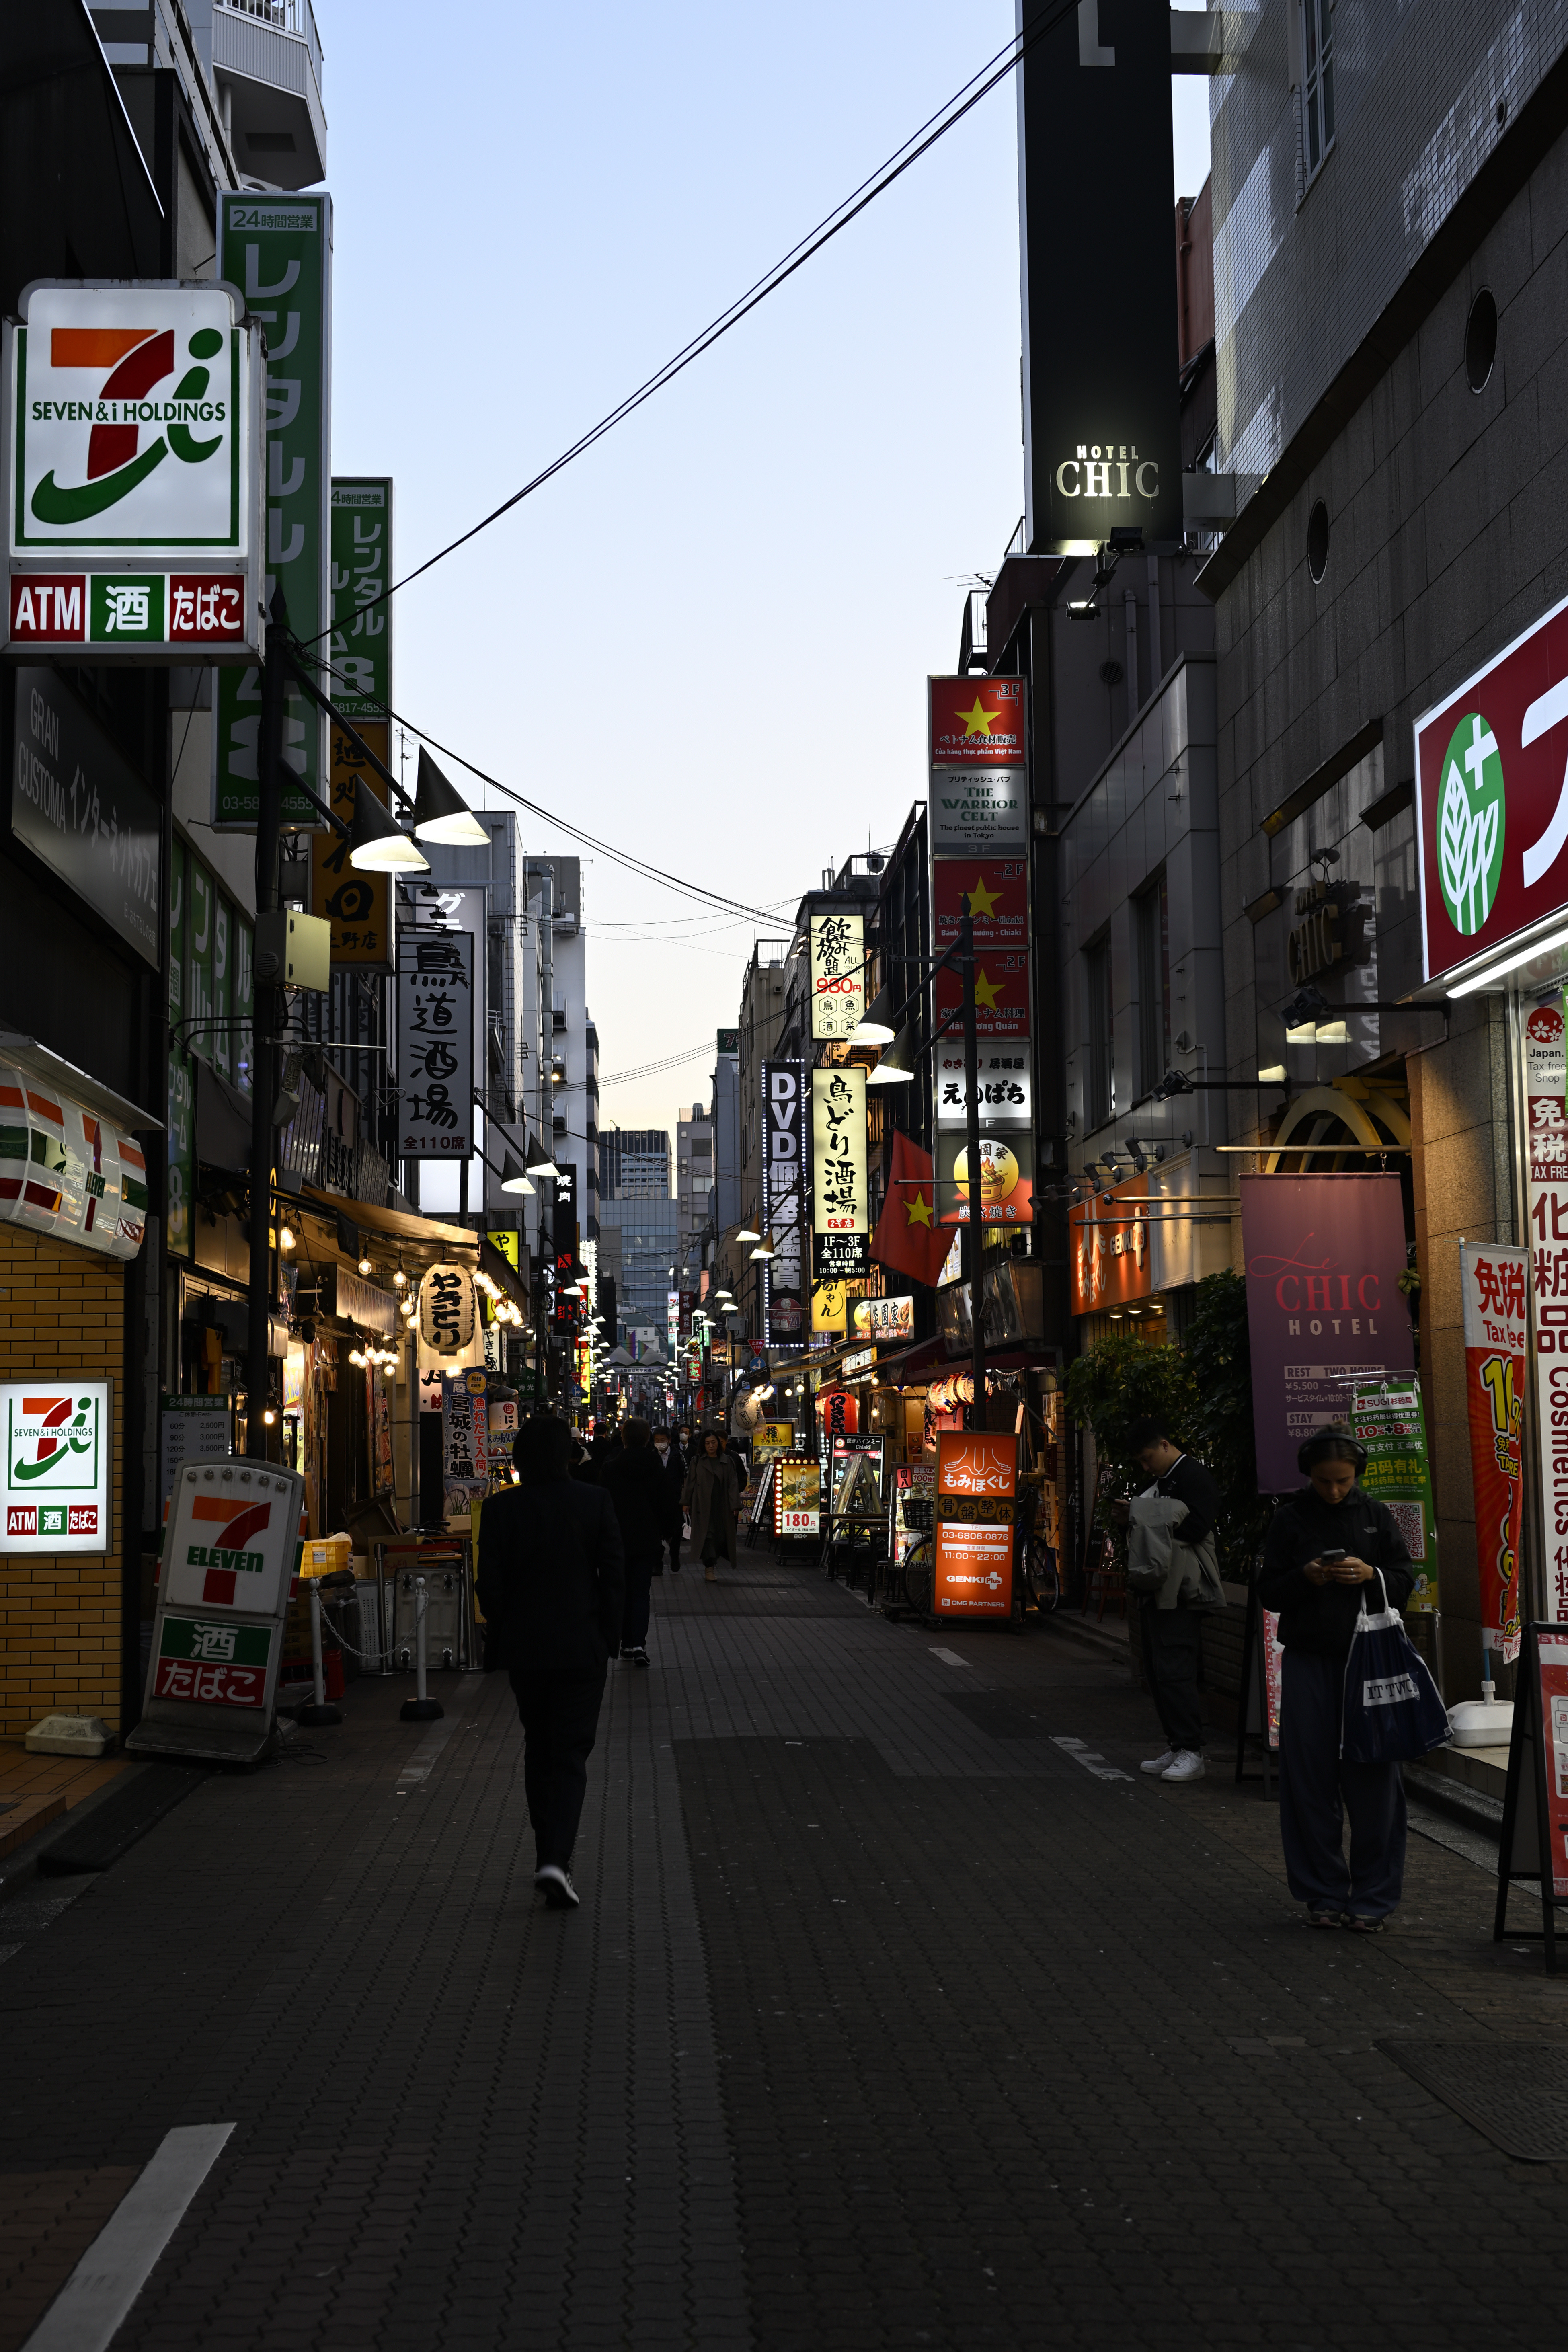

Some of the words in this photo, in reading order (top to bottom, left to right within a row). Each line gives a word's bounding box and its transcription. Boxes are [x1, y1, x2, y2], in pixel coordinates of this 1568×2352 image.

[232, 210, 314, 229] 24時間営業
[123, 402, 226, 422] HOLDINGS
[1077, 445, 1138, 459] HOTEL
[1056, 462, 1159, 497] CHIC
[351, 516, 384, 636] レンタル
[15, 586, 80, 630] ATM
[105, 585, 150, 633] 酒
[173, 585, 241, 631] たばこ
[31, 687, 59, 761] GRAN
[940, 734, 1017, 745] ベトナム食材販売
[18, 741, 67, 835] CUSTOMA
[964, 787, 993, 797] THE
[940, 798, 1018, 809] WARRIOR
[961, 811, 998, 821] CELT
[70, 763, 157, 913] インターネットカフェ
[817, 978, 861, 993] 980円
[823, 1001, 833, 1010] 鳥
[845, 1000, 855, 1010] 魚
[823, 1022, 833, 1031] 酒
[846, 1021, 855, 1031] 菜
[995, 1022, 1018, 1030] Quán
[1530, 1048, 1564, 1059] Japan.
[989, 1058, 1024, 1069] 居酒屋
[1528, 1062, 1566, 1071] Tax-free
[1535, 1073, 1560, 1084] Shop
[1532, 1098, 1567, 1163] 免税
[404, 1136, 465, 1150] 全110席
[823, 1075, 857, 1215] 鳥どり酒場
[556, 1175, 573, 1202] 焼肉
[768, 1072, 801, 1289] DVD個室鑑賞
[830, 1219, 852, 1227] 2号店
[1110, 1229, 1133, 1256] GENKI
[1133, 1229, 1143, 1245] Plus
[821, 1247, 862, 1259] 全110席
[1078, 1260, 1106, 1303] もみほぐし
[1276, 1274, 1381, 1311] CHIC
[429, 1273, 462, 1346] やきとり
[1289, 1319, 1377, 1335] HOTEL
[1483, 1320, 1506, 1343] Tax
[688, 1362, 700, 1377] 和光
[1287, 1368, 1311, 1377] REST
[1324, 1367, 1346, 1377] TWO
[1285, 1382, 1318, 1391] ¥5,500
[169, 1398, 224, 1407] 24時間営業
[1367, 1398, 1390, 1407] SUGI
[1391, 1397, 1412, 1405] 杉药局
[1289, 1414, 1313, 1423] STAY
[51, 1428, 93, 1437] HOLDINGS
[449, 1394, 475, 1479] 宮城の牡蠣
[944, 1472, 1010, 1492] もみほぐし
[942, 1499, 1011, 1521] 骨盤整体
[8, 1512, 35, 1531] ATM
[43, 1511, 62, 1530] 酒
[69, 1511, 97, 1529] たばこ
[785, 1514, 816, 1526] 180円
[942, 1532, 1008, 1541] 03-6806-0876
[946, 1575, 984, 1583] GENKI
[190, 1623, 240, 1662] 酒
[161, 1661, 256, 1703] たばこ
